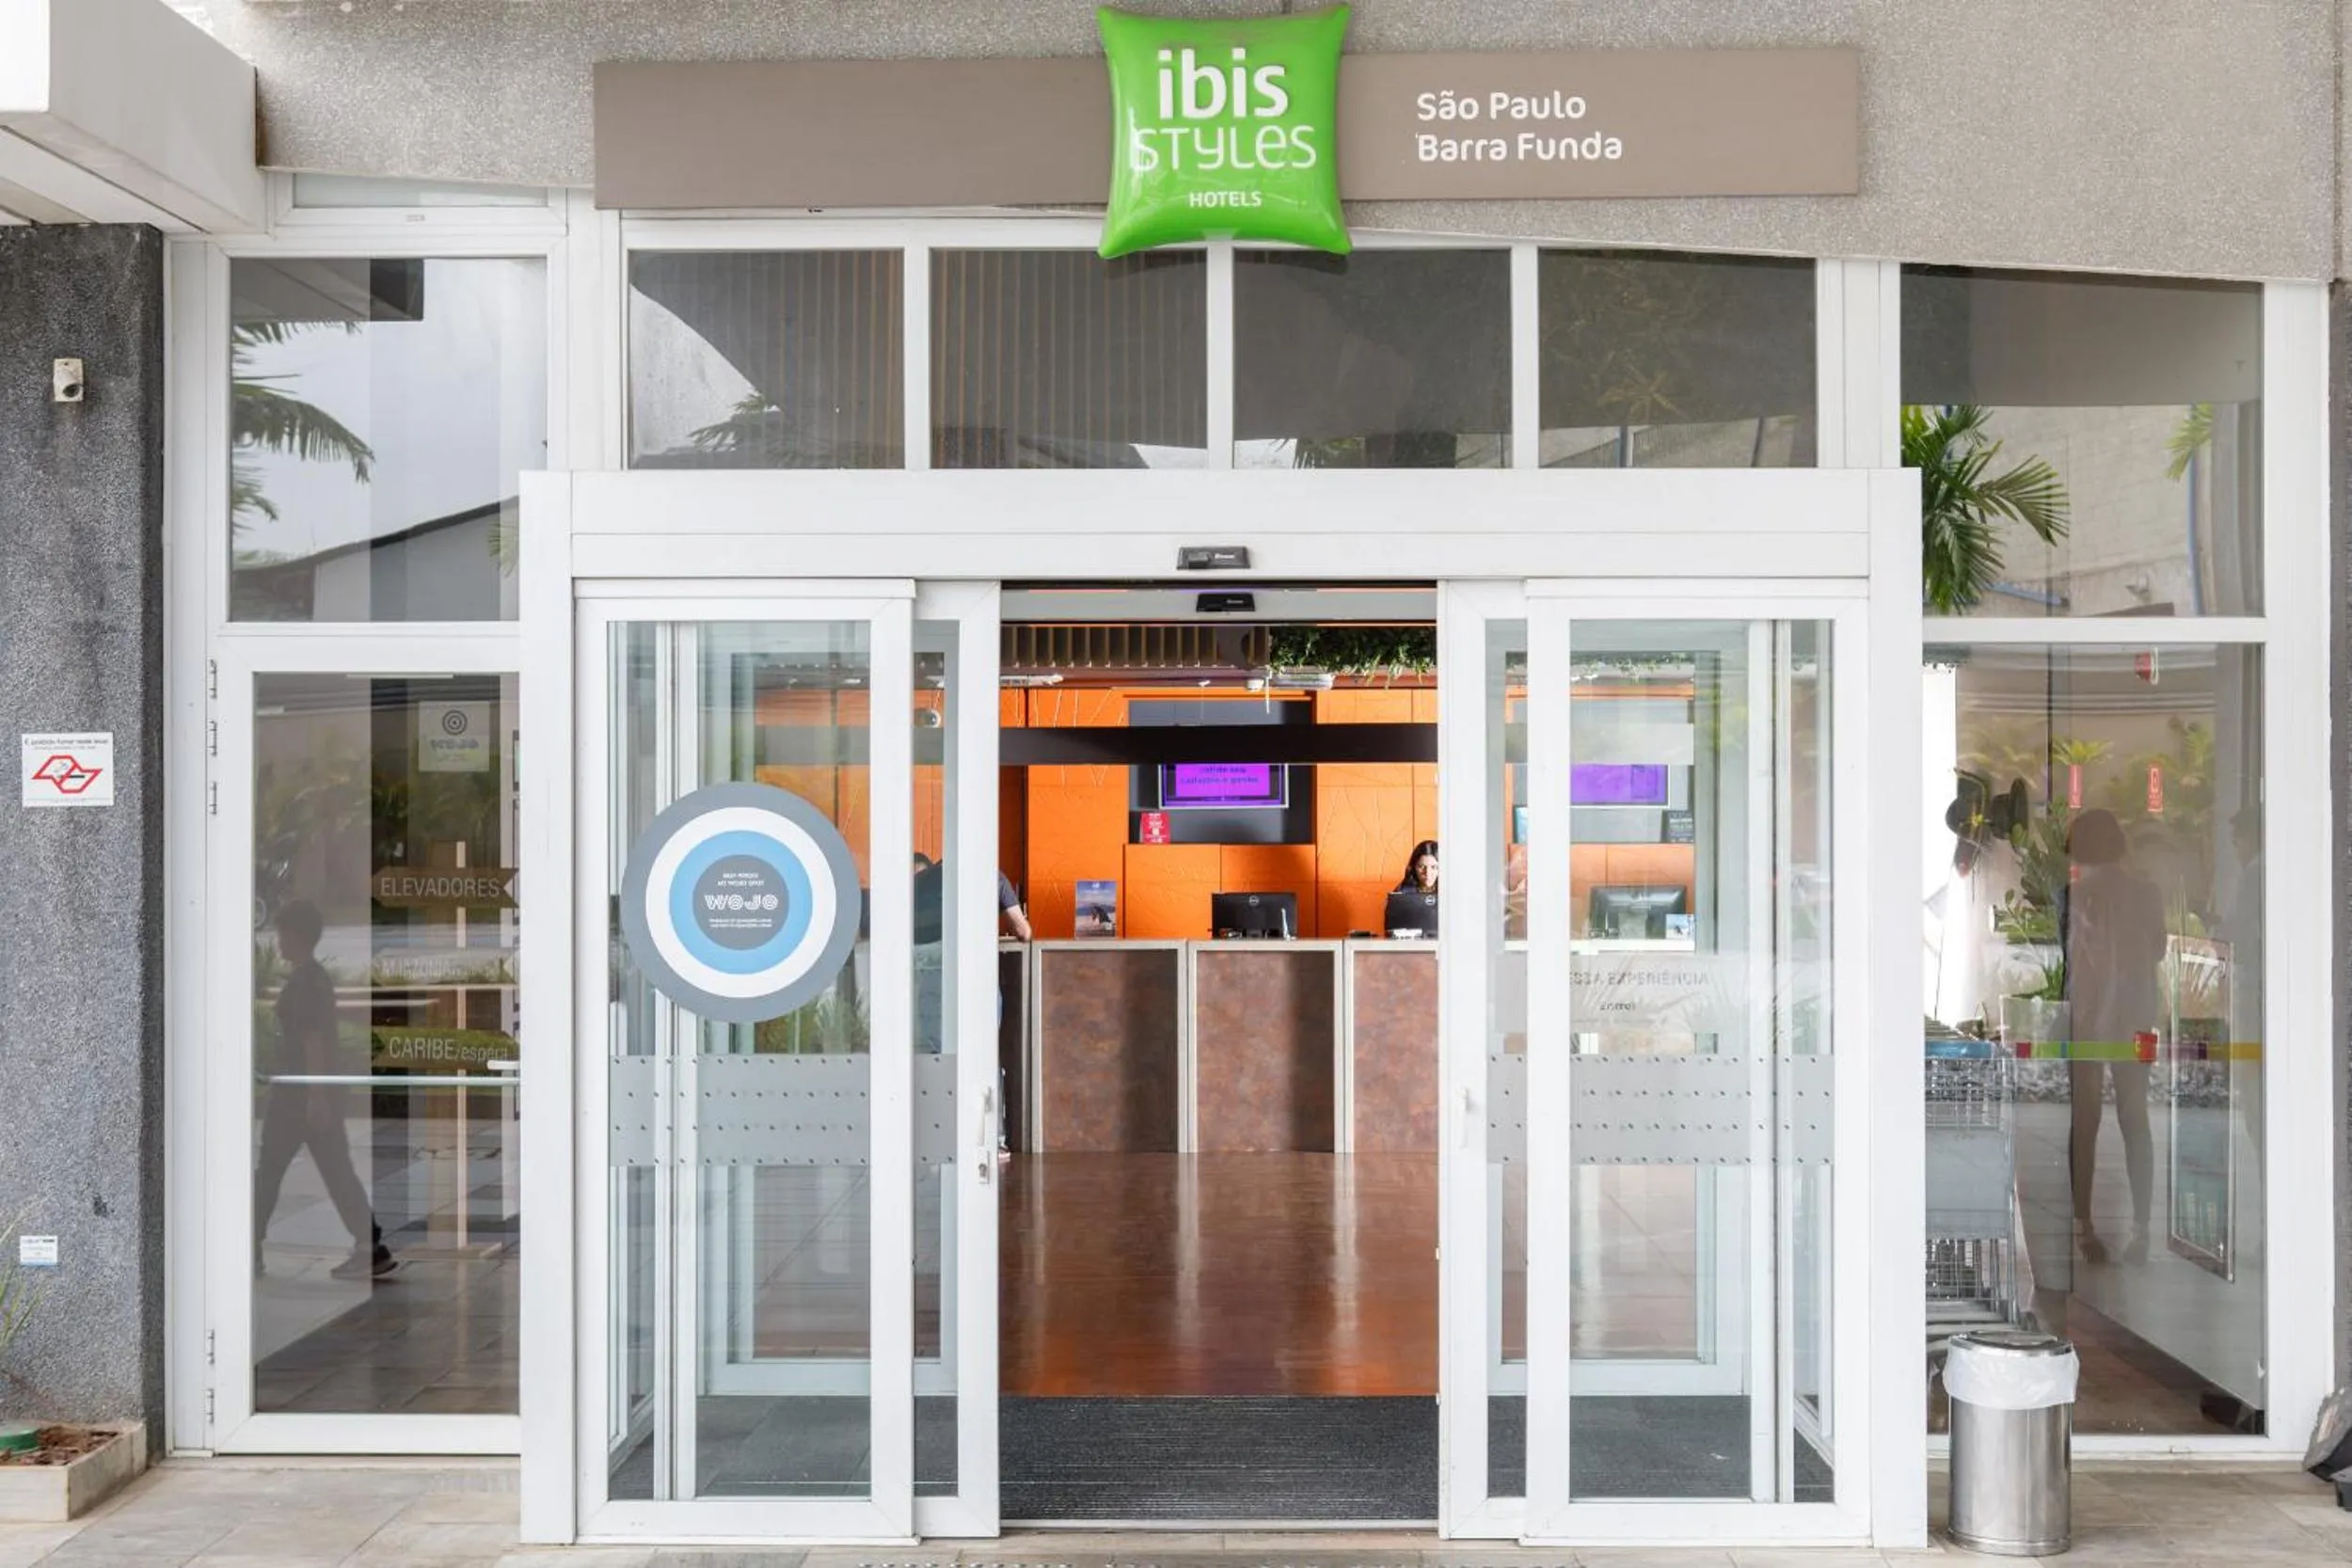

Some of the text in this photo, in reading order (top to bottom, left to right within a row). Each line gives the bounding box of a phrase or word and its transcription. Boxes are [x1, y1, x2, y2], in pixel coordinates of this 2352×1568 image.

[1157, 47, 1289, 120] ibis
[1416, 90, 1586, 121] São Paulo
[1416, 132, 1623, 163] Barra Funda
[1188, 190, 1263, 209] HOTELS
[381, 876, 501, 898] ELEVADORES
[704, 894, 779, 911] WOJO
